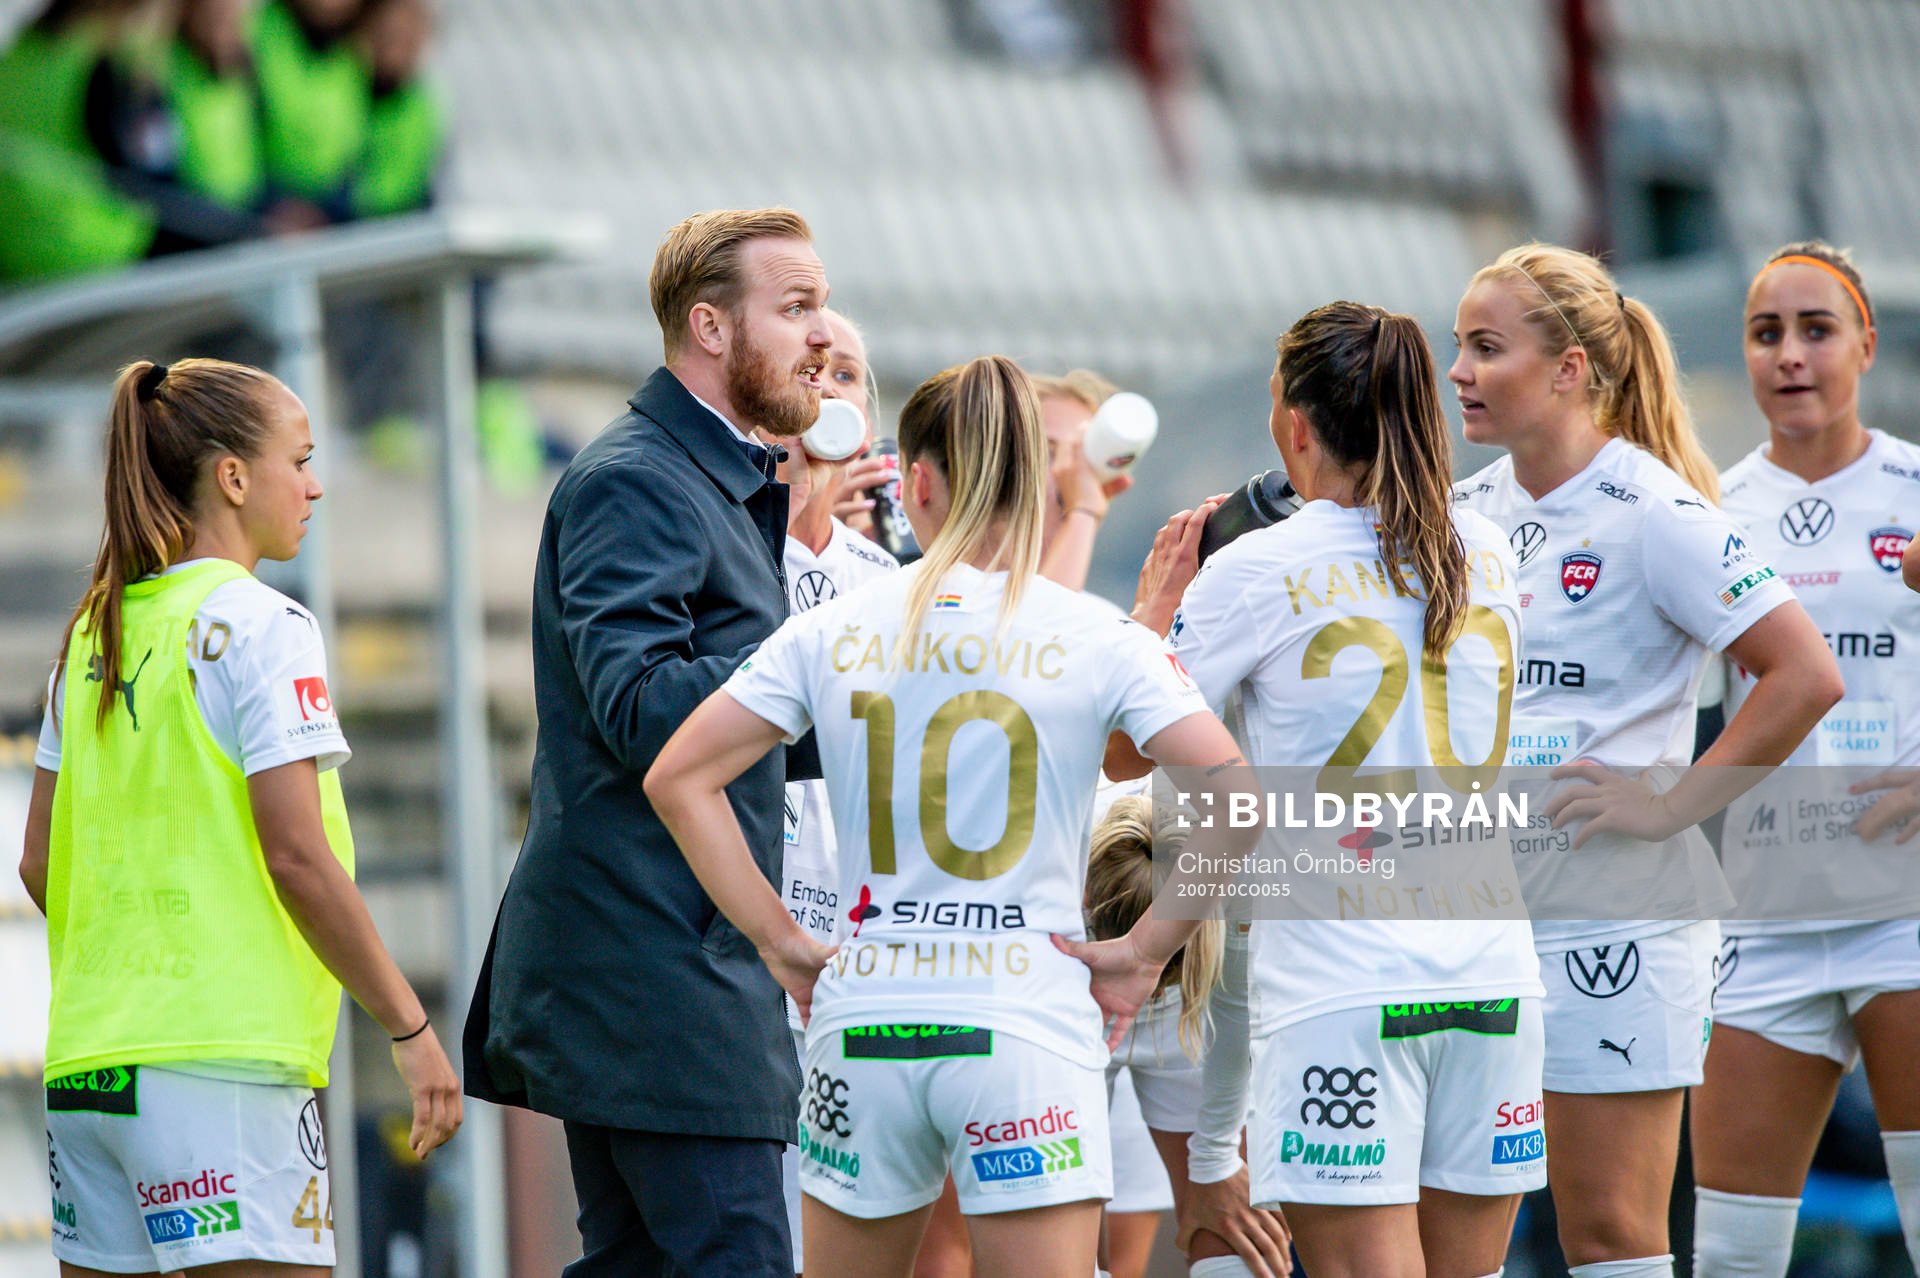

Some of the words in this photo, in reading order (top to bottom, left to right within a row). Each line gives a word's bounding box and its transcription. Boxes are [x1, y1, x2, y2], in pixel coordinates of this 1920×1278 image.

[1564, 565, 1597, 580] FCR
[831, 624, 1067, 680] ČANKOVIĆ
[1302, 604, 1514, 806] 20
[850, 690, 1038, 881] 10
[791, 880, 838, 908] Emba
[964, 1105, 1078, 1147] Scandic
[1495, 1100, 1543, 1127] Scan
[1501, 1134, 1541, 1159] MKB
[982, 1151, 1035, 1177] MKB
[137, 1168, 236, 1208] Scandic
[152, 1214, 187, 1239] MKB
